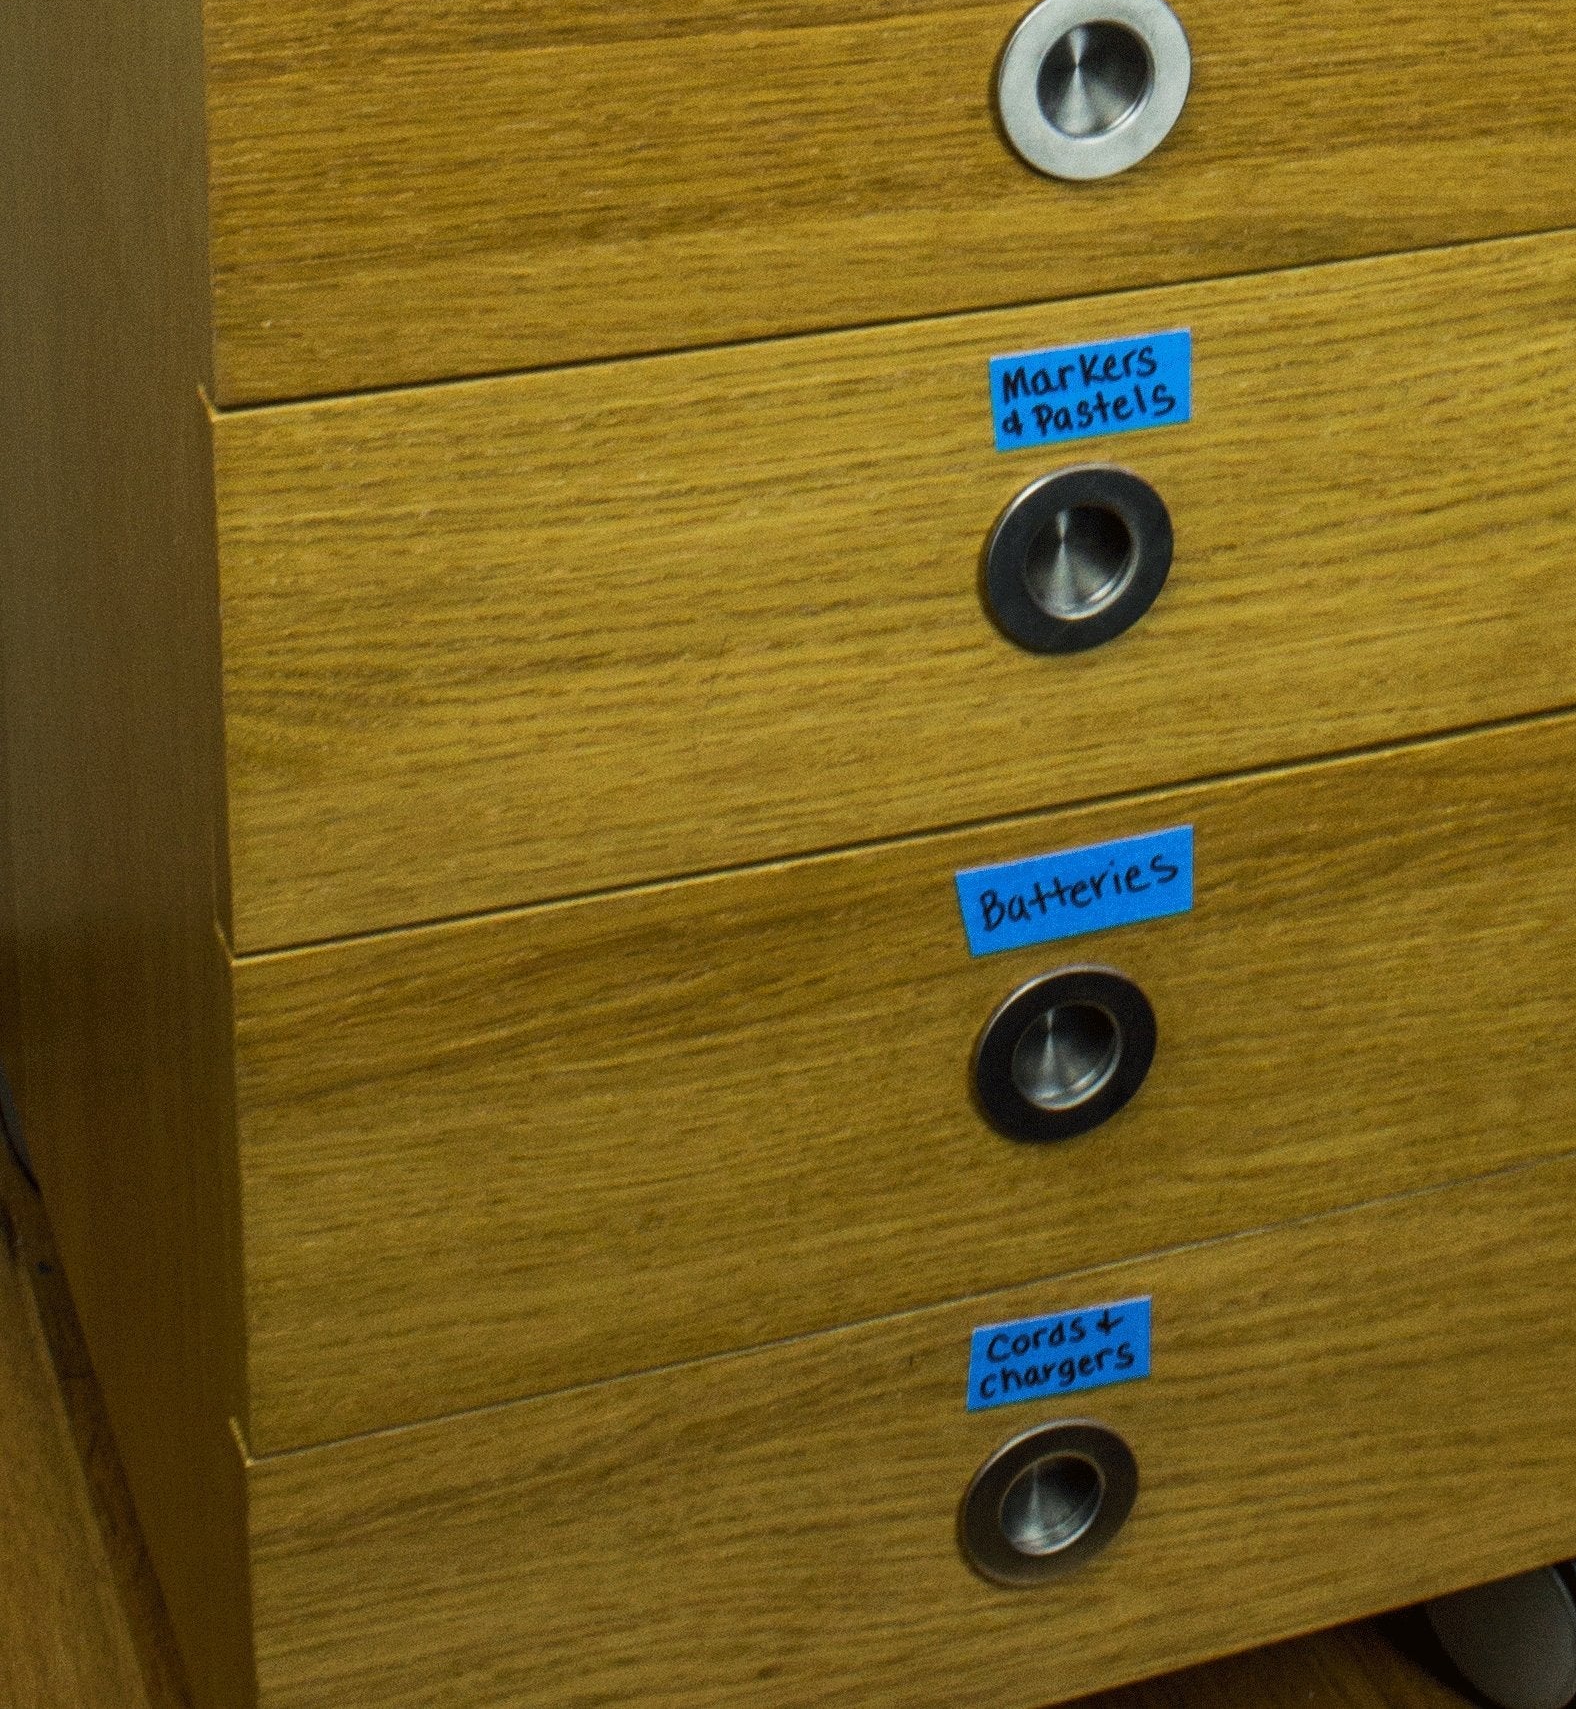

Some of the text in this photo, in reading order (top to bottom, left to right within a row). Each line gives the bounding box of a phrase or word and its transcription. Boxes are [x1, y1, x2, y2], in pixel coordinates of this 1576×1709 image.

[1002, 344, 1158, 406] Markers
[1031, 382, 1177, 438] Pastels
[979, 852, 1179, 932] Batteries
[985, 1315, 1087, 1364] Cords
